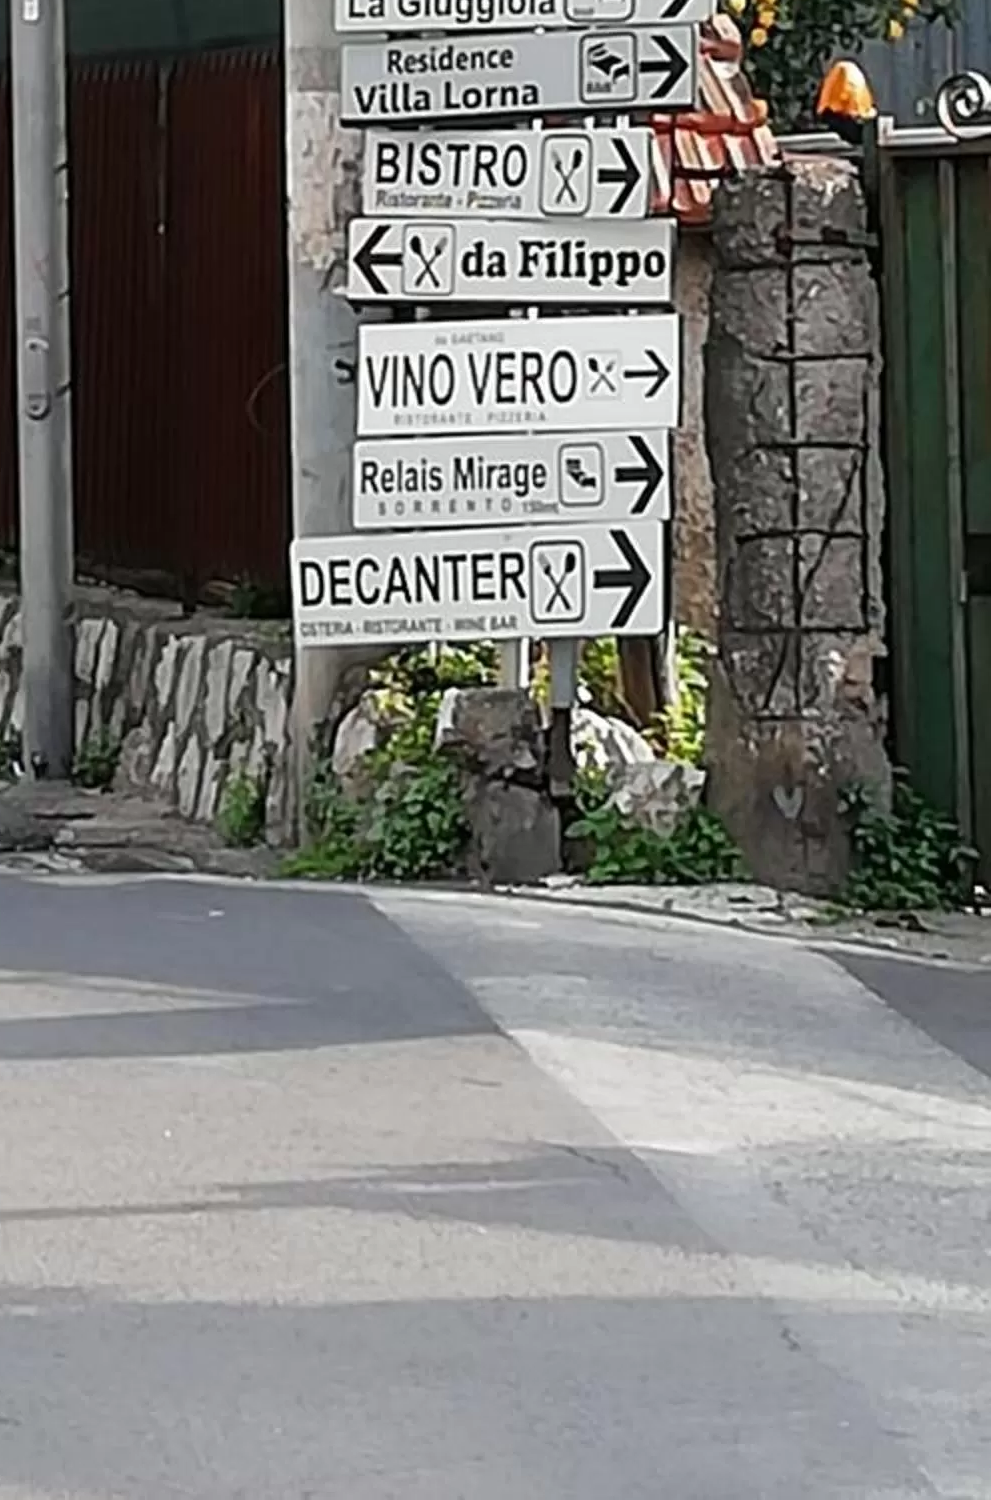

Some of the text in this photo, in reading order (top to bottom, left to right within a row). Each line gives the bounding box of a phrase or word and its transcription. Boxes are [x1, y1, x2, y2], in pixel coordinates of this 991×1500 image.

[386, 45, 514, 75] Residence
[354, 82, 539, 114] Villa Lorna
[375, 142, 528, 187] BISTRO
[376, 190, 452, 209] Ristorante
[461, 240, 666, 286] da Filippo
[365, 349, 578, 408] VINO VERO
[393, 410, 546, 426] RISTORANTE PIZZERIA
[360, 457, 547, 497] Relais Mirage
[299, 551, 527, 607] DECANTER
[363, 617, 442, 635] RISTORANTE
